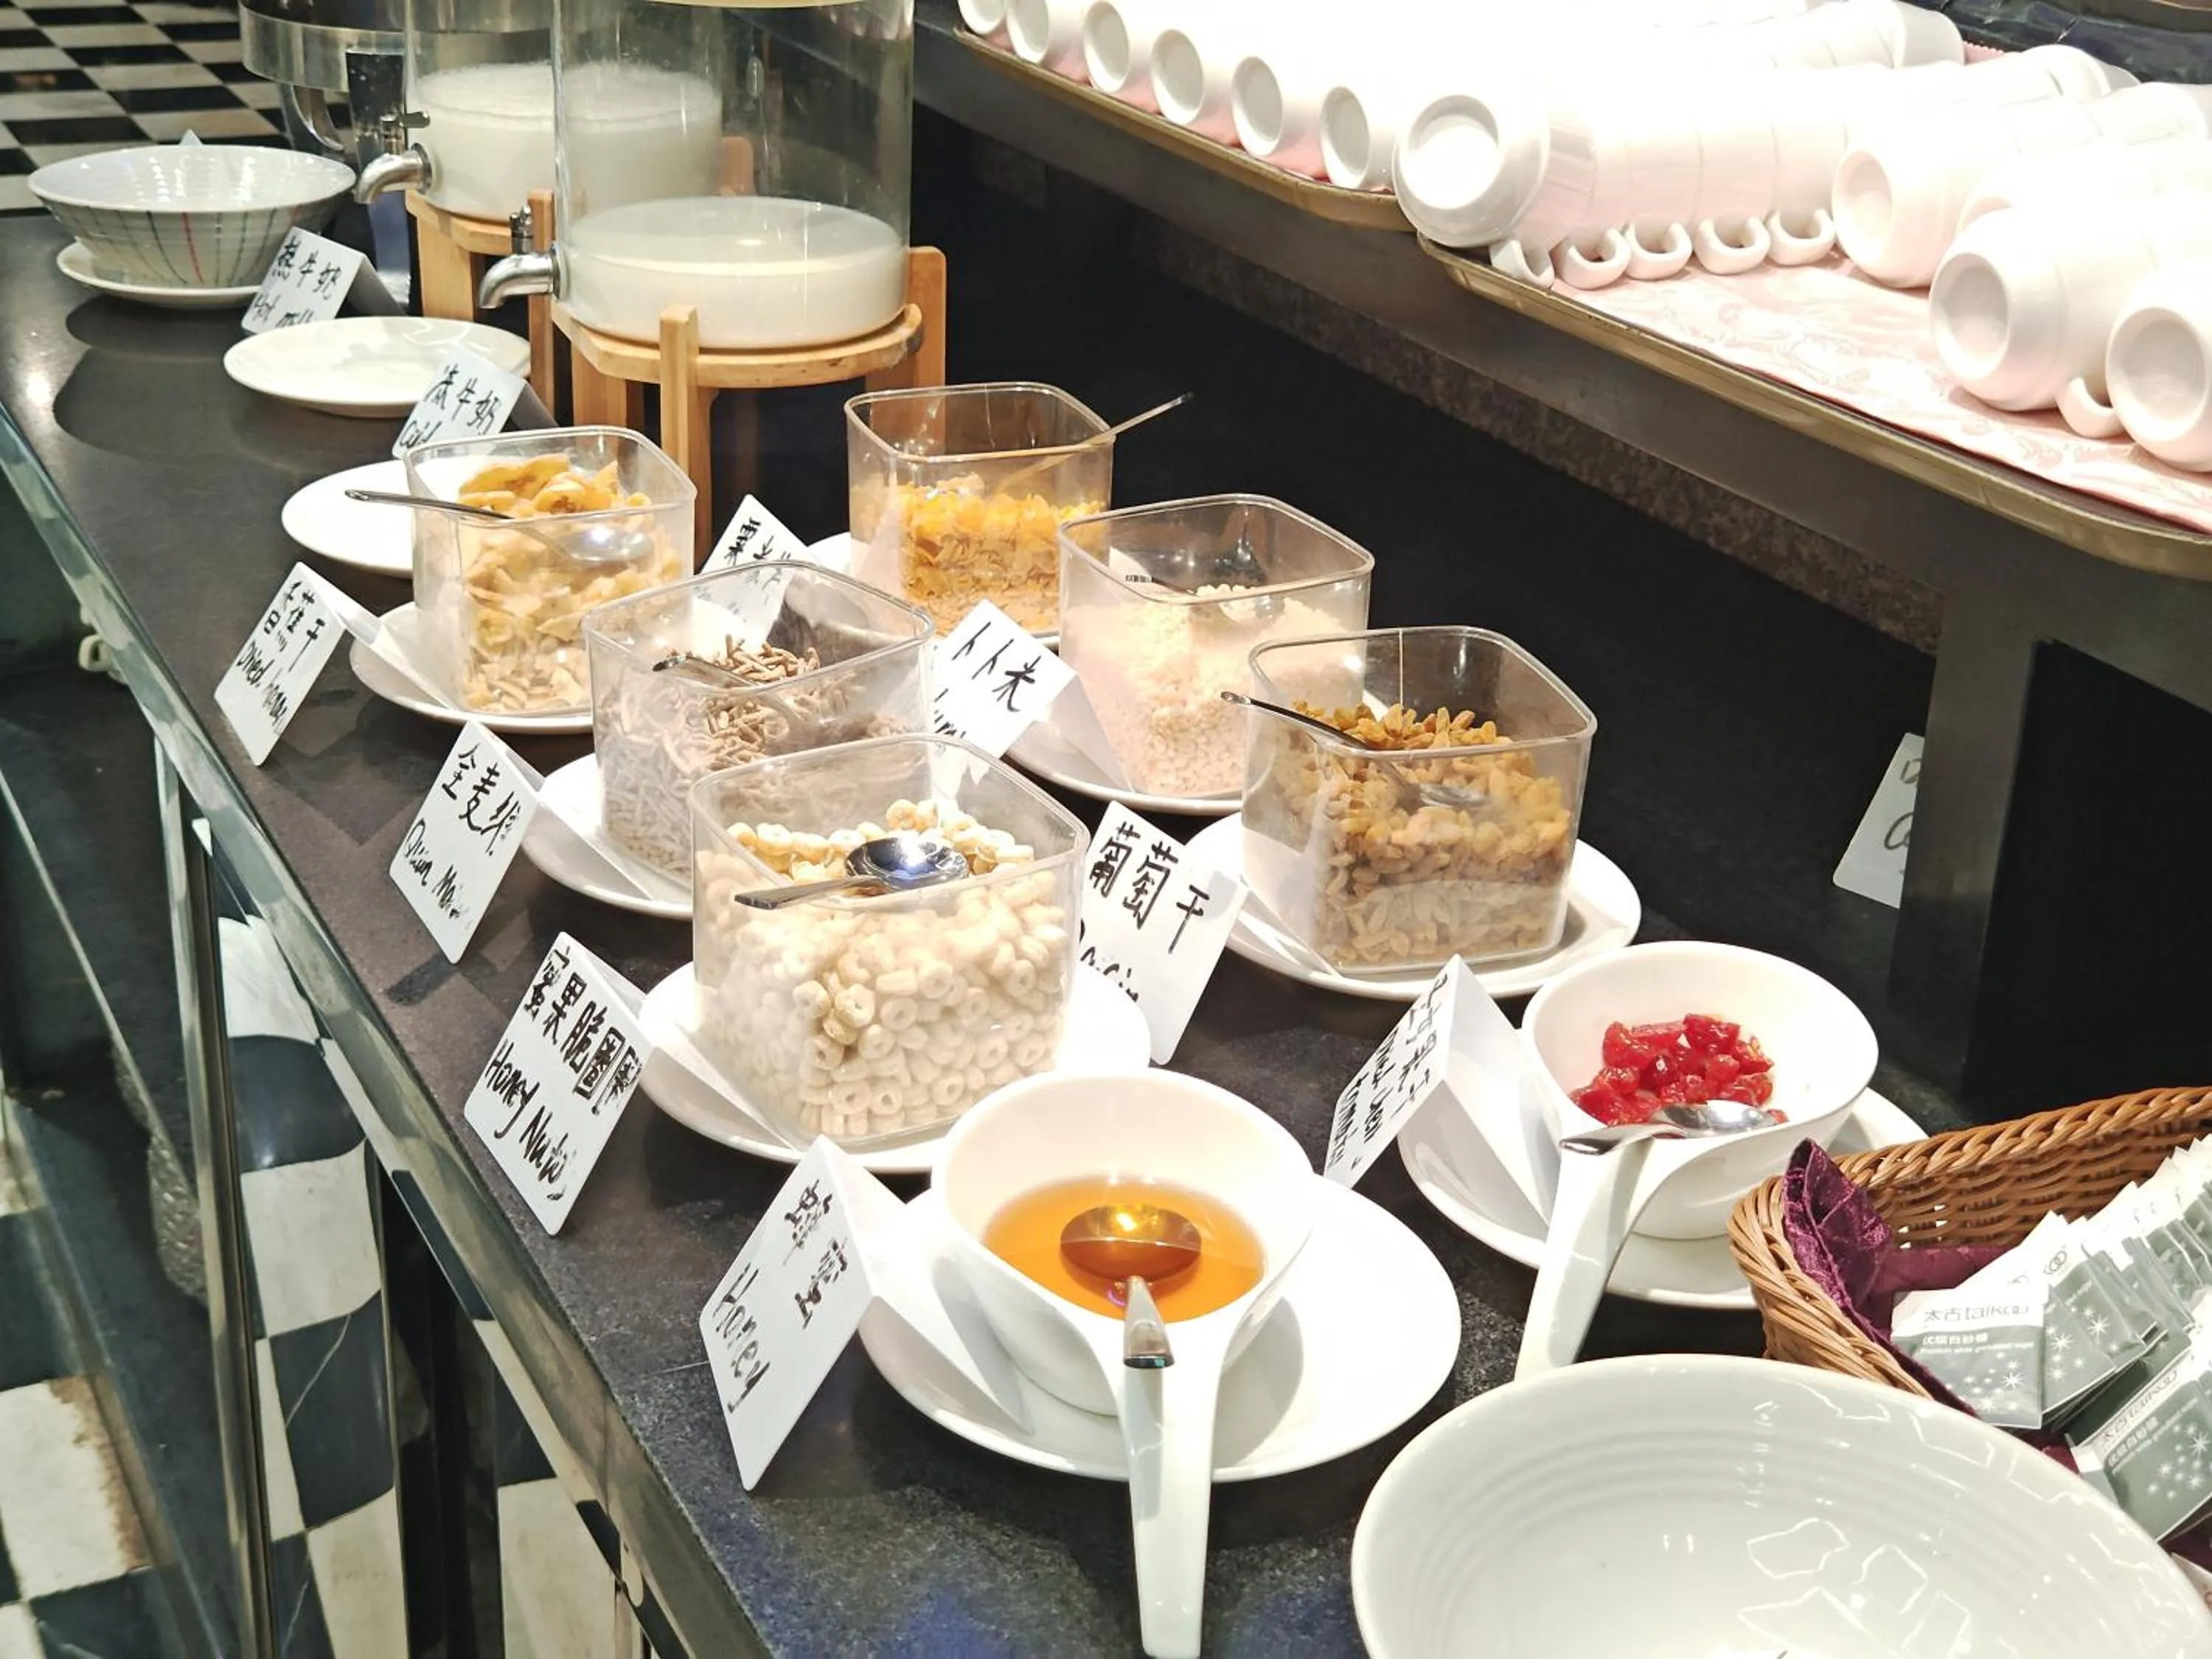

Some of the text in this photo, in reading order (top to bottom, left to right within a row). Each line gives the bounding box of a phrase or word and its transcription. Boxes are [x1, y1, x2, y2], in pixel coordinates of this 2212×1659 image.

[1089, 821, 1209, 953] 葡萄干
[484, 1038, 540, 1139] Honey
[712, 1262, 771, 1413] Honey
